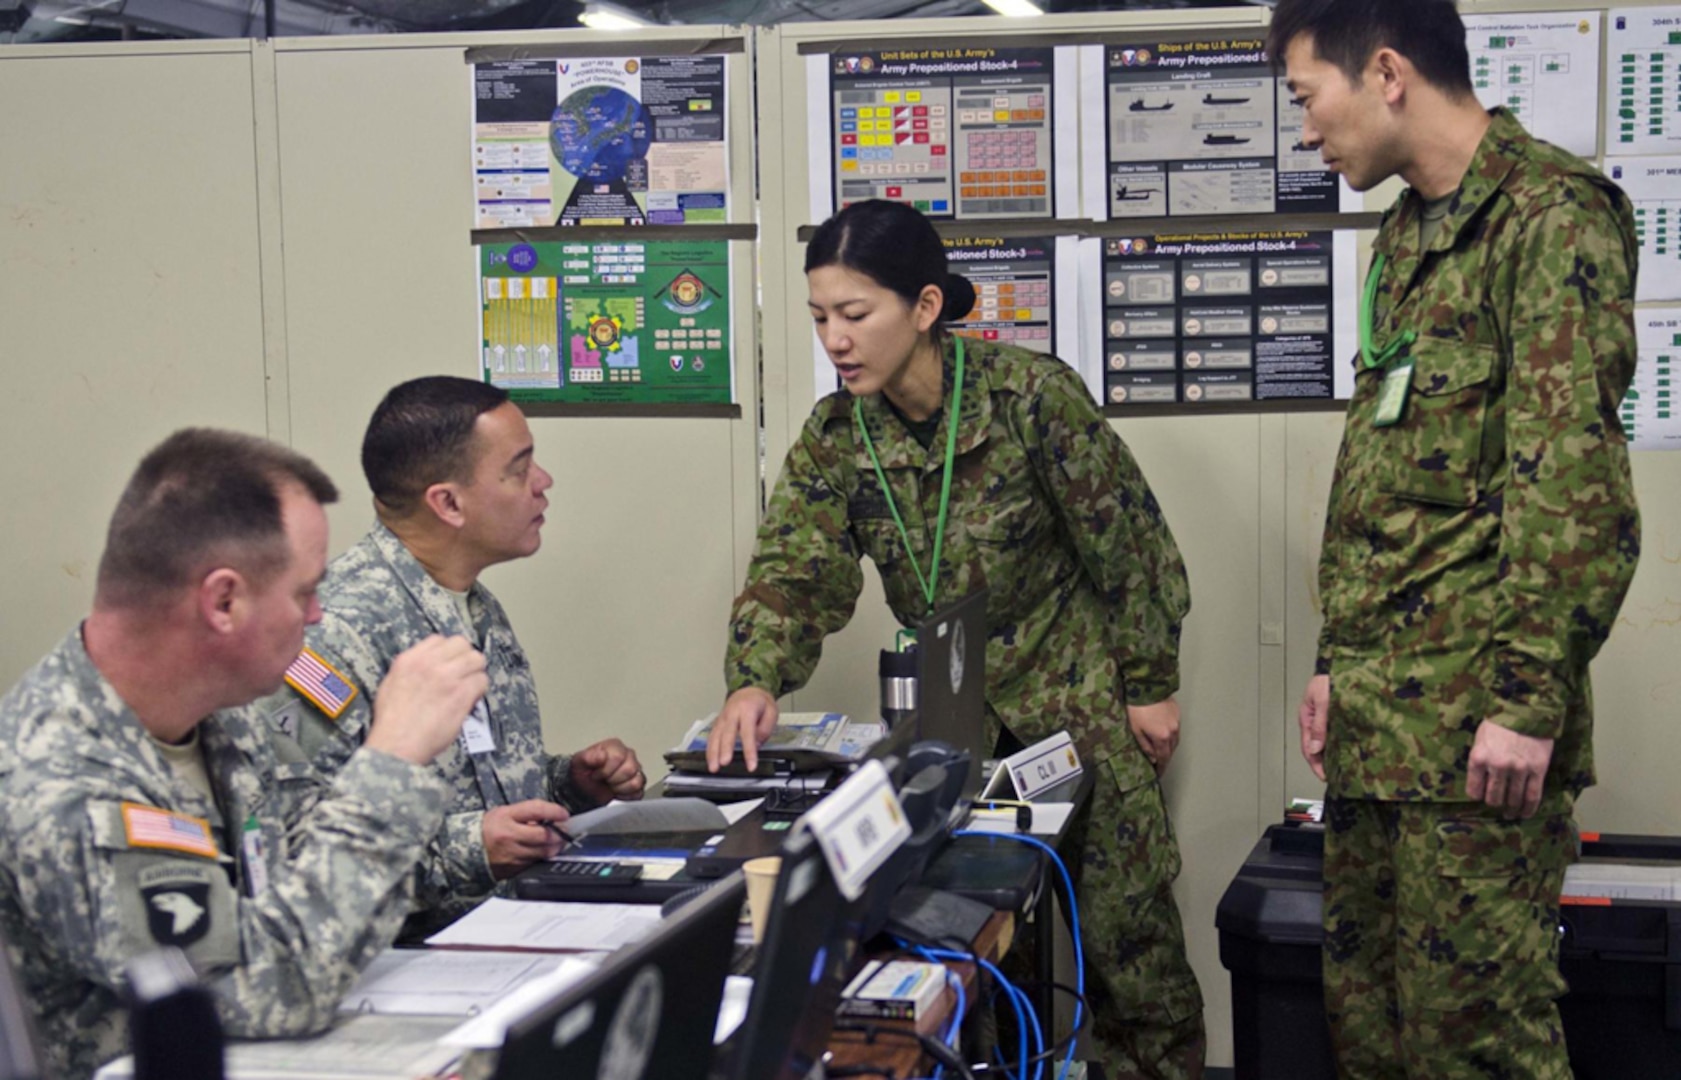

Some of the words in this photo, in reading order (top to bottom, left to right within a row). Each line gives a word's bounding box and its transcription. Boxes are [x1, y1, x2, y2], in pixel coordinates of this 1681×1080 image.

[1541, 23, 1576, 31] Organization
[1158, 43, 1182, 53] Ships
[1184, 43, 1193, 52] of
[1195, 42, 1210, 51] the
[1211, 41, 1227, 50] U.S.
[1231, 40, 1262, 51] Army's
[881, 51, 898, 60] Unit
[900, 50, 918, 60] Sets
[920, 50, 929, 58] of
[931, 50, 945, 58] the
[946, 49, 962, 58] U.S.
[965, 48, 995, 59] Army's
[1158, 56, 1186, 68] Army
[1187, 52, 1260, 66] Prepositioned
[881, 63, 908, 75] Army
[909, 61, 978, 74] Prepositioned
[979, 59, 1018, 71] Stock-4
[974, 237, 1004, 246] Army's
[988, 247, 1026, 259] Stock-3
[1155, 244, 1183, 256] Army
[1184, 241, 1255, 255] Prepositioned
[1256, 240, 1296, 251] Stock-4
